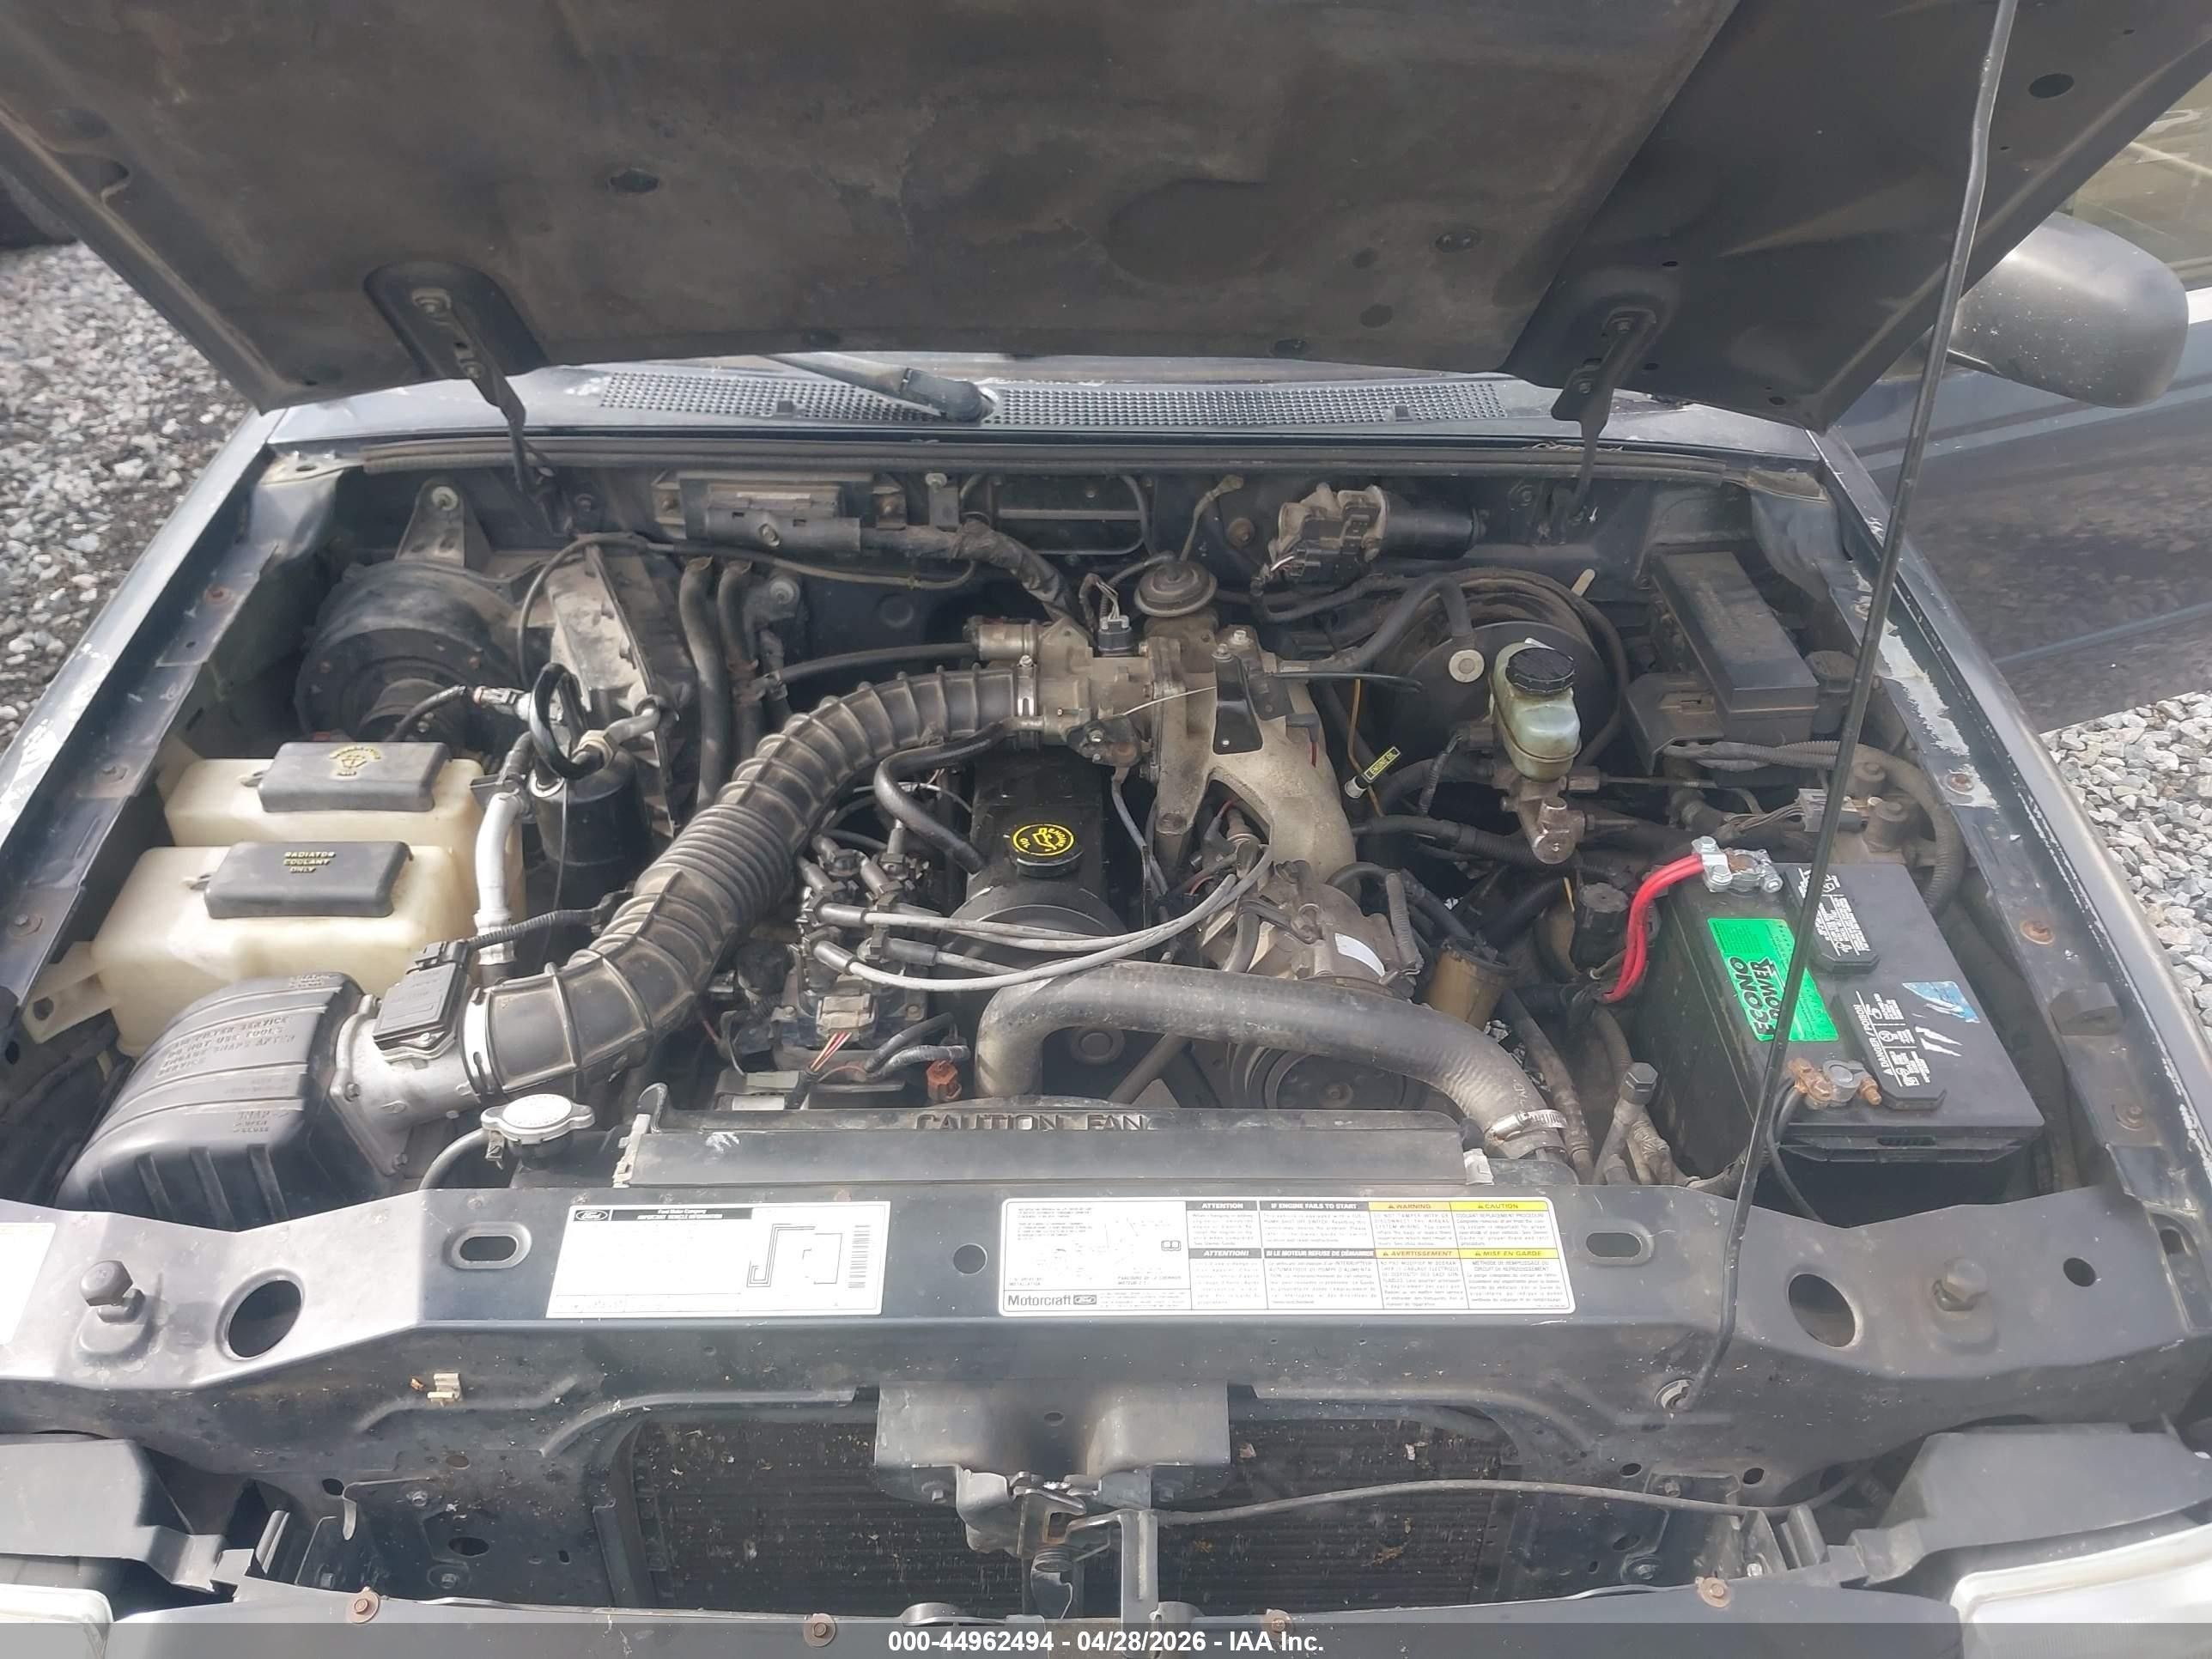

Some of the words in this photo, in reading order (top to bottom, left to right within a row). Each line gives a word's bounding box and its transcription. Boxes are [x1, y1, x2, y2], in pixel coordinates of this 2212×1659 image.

[1019, 838, 1031, 848] OIL
[1048, 828, 1067, 848] ENGINE
[1729, 957, 1773, 1035] ECONO
[915, 1114, 1060, 1131] CAUTION
[1086, 1114, 1145, 1131] FAN
[1008, 1295, 1072, 1306] Motorcraft
